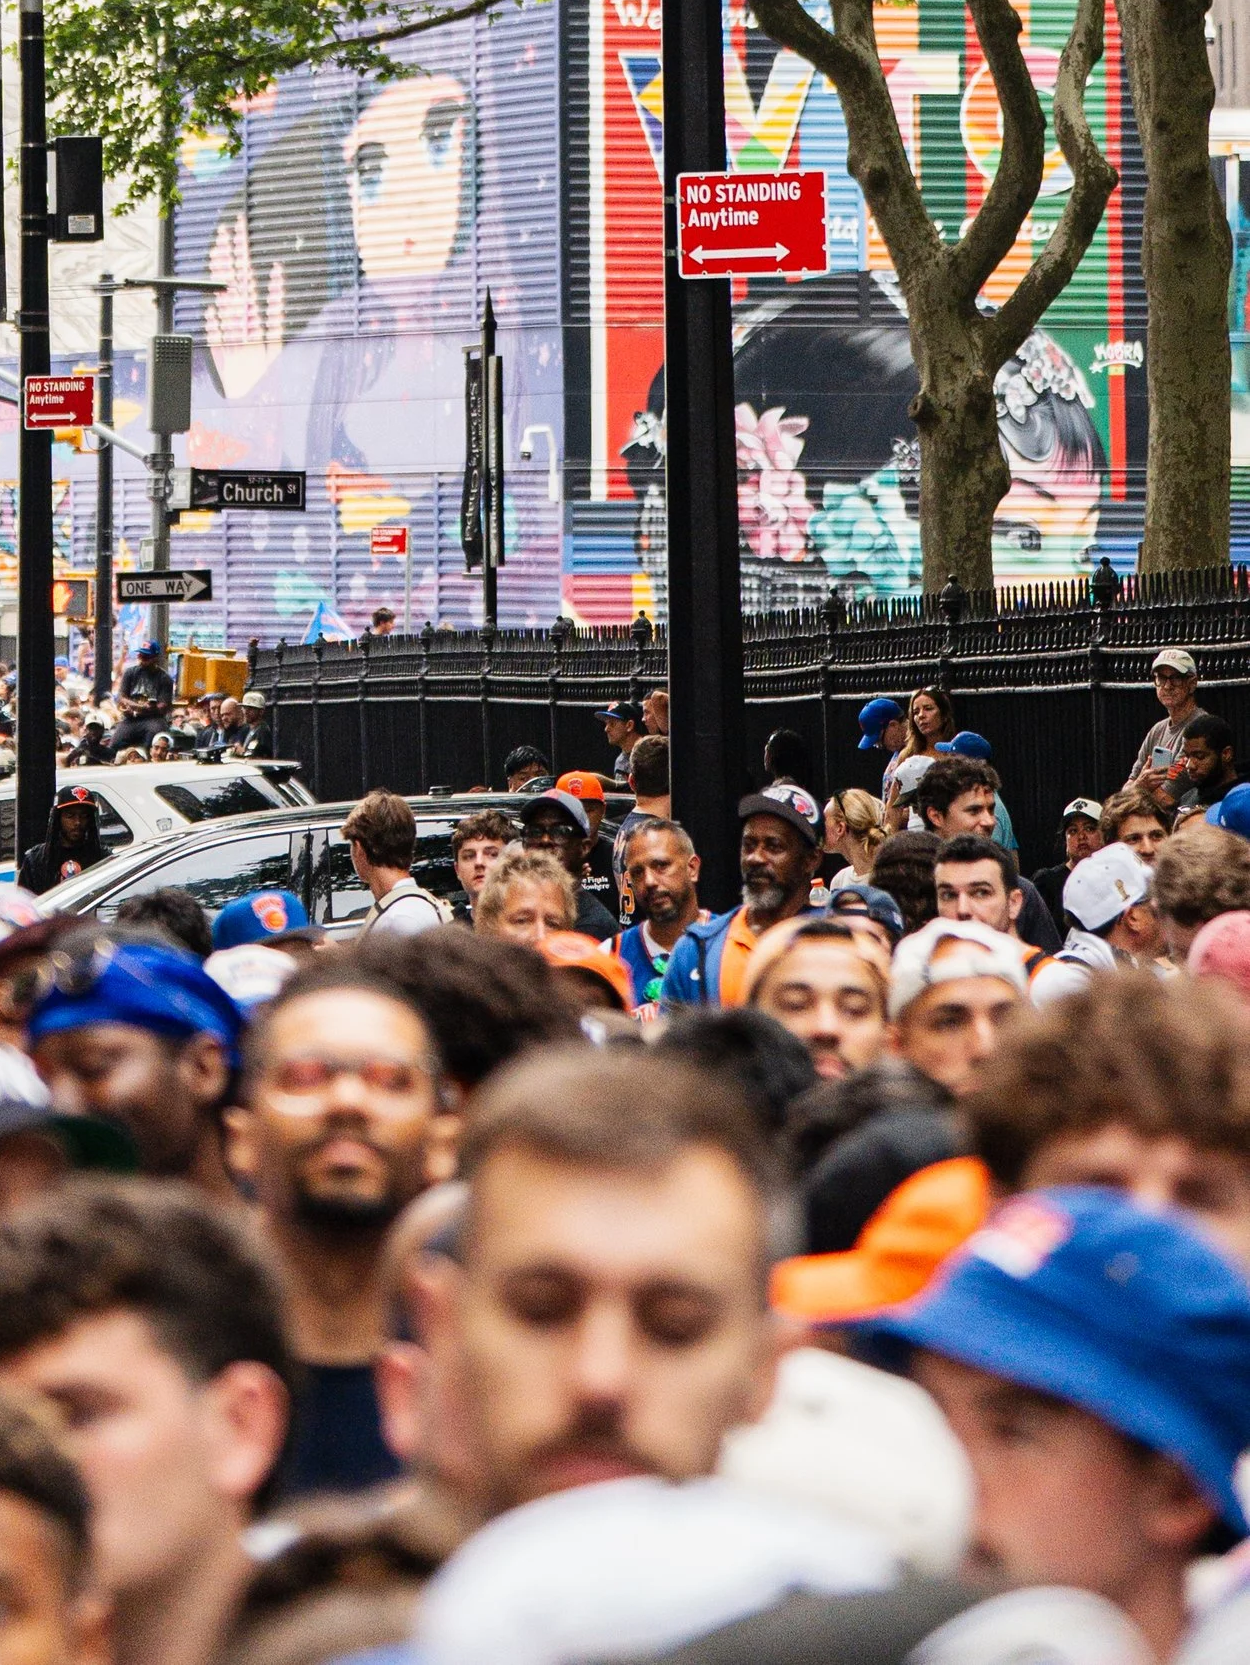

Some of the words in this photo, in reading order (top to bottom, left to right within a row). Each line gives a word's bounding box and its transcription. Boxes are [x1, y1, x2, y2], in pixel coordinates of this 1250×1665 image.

[686, 184, 711, 204] NO
[715, 182, 802, 203] STANDING
[688, 208, 760, 231] Anytime
[29, 382, 42, 392] NO
[43, 381, 86, 392] STANDING
[29, 393, 65, 407] Anytime
[222, 482, 283, 502] Church
[287, 484, 297, 494] St
[126, 582, 152, 595] ONE
[165, 579, 193, 594] WAY
